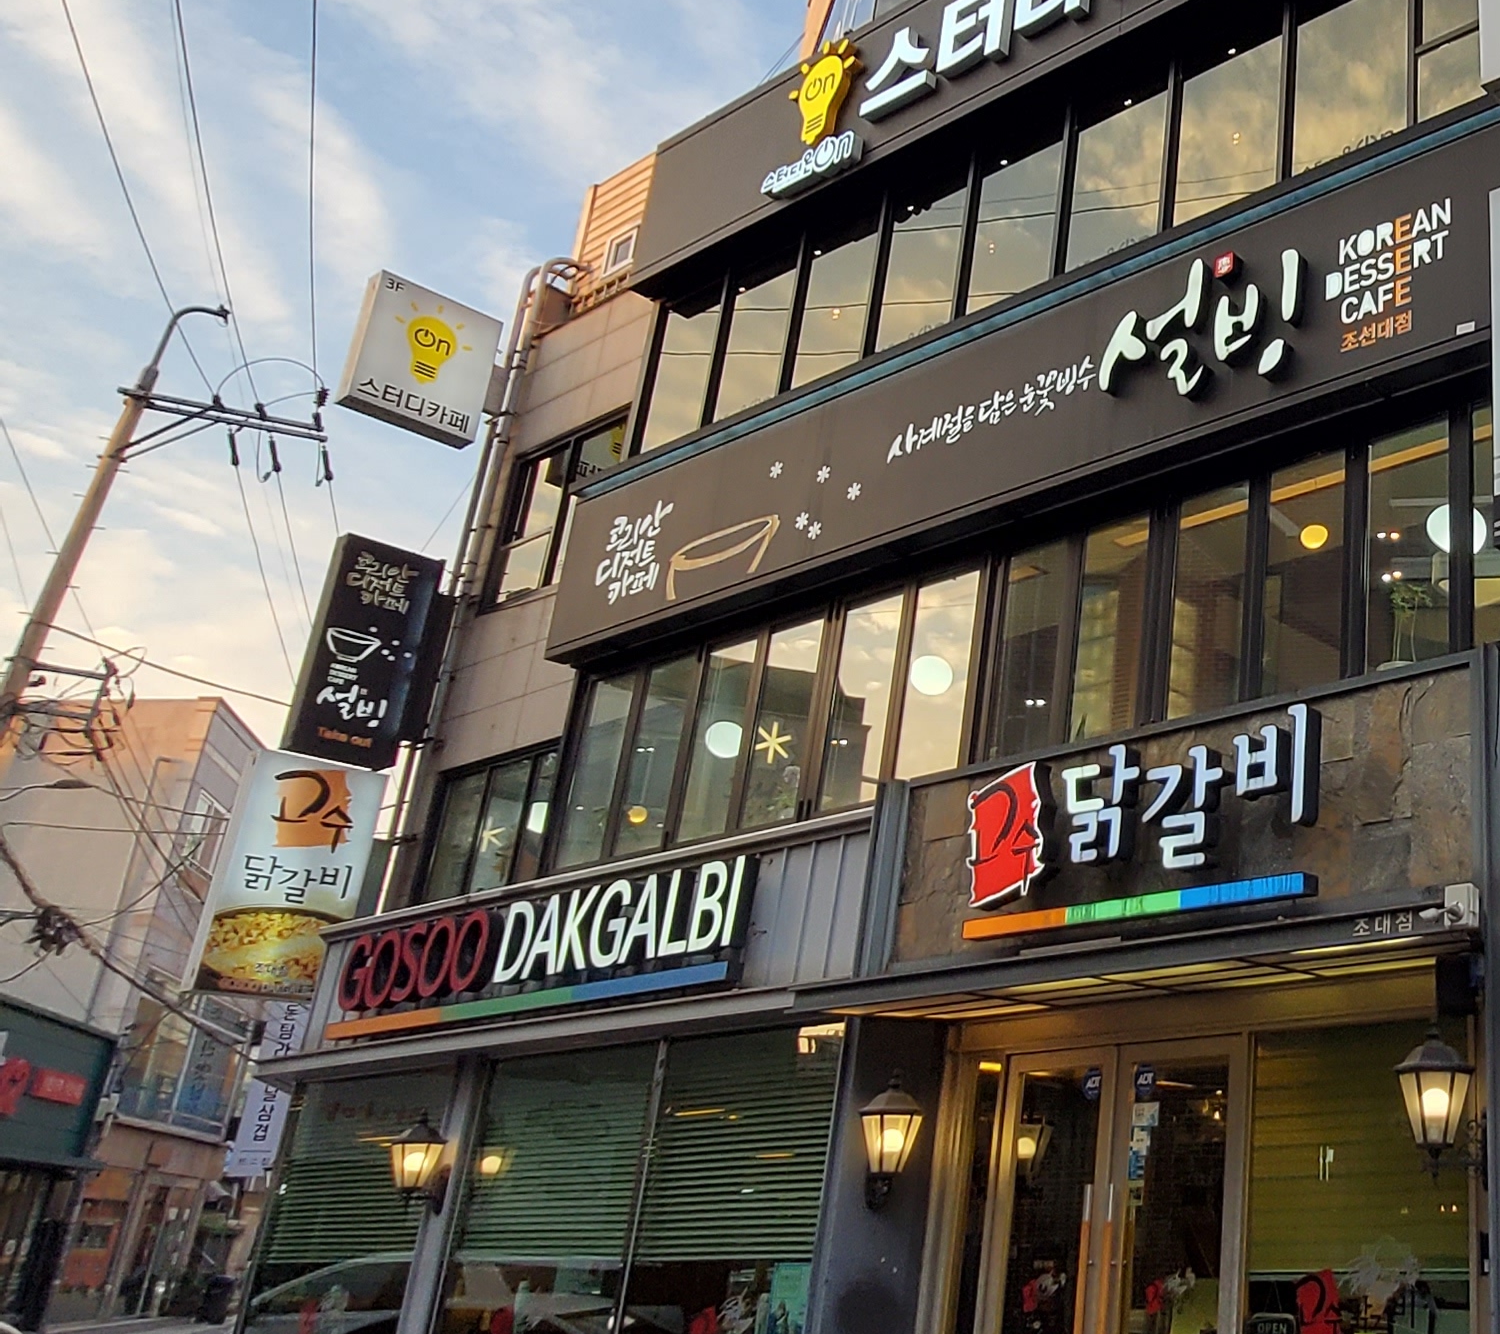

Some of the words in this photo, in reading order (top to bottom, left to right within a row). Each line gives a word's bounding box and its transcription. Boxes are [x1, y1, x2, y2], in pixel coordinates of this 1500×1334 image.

[804, 73, 835, 101] On
[1338, 197, 1451, 266] KOREAN
[385, 278, 404, 292] 3F
[1325, 229, 1450, 301] DESSERT
[1340, 275, 1412, 324] CAFE
[414, 328, 451, 356] On
[978, 389, 1019, 426] 담은
[1099, 247, 1301, 396] 설빙
[1340, 309, 1412, 353] 조선대점
[357, 378, 470, 433] 스터디카페
[595, 538, 656, 586] 디저트
[608, 561, 660, 605] 카페
[316, 684, 388, 728] 설빙
[1061, 703, 1307, 869] 닭갈비
[271, 770, 354, 854] 고수
[244, 854, 353, 905] 닭갈비
[338, 909, 489, 1011] GOSOO
[494, 854, 746, 984] DAKGALBI
[1352, 911, 1413, 937] 조대점
[1136, 1072, 1154, 1085] ADT
